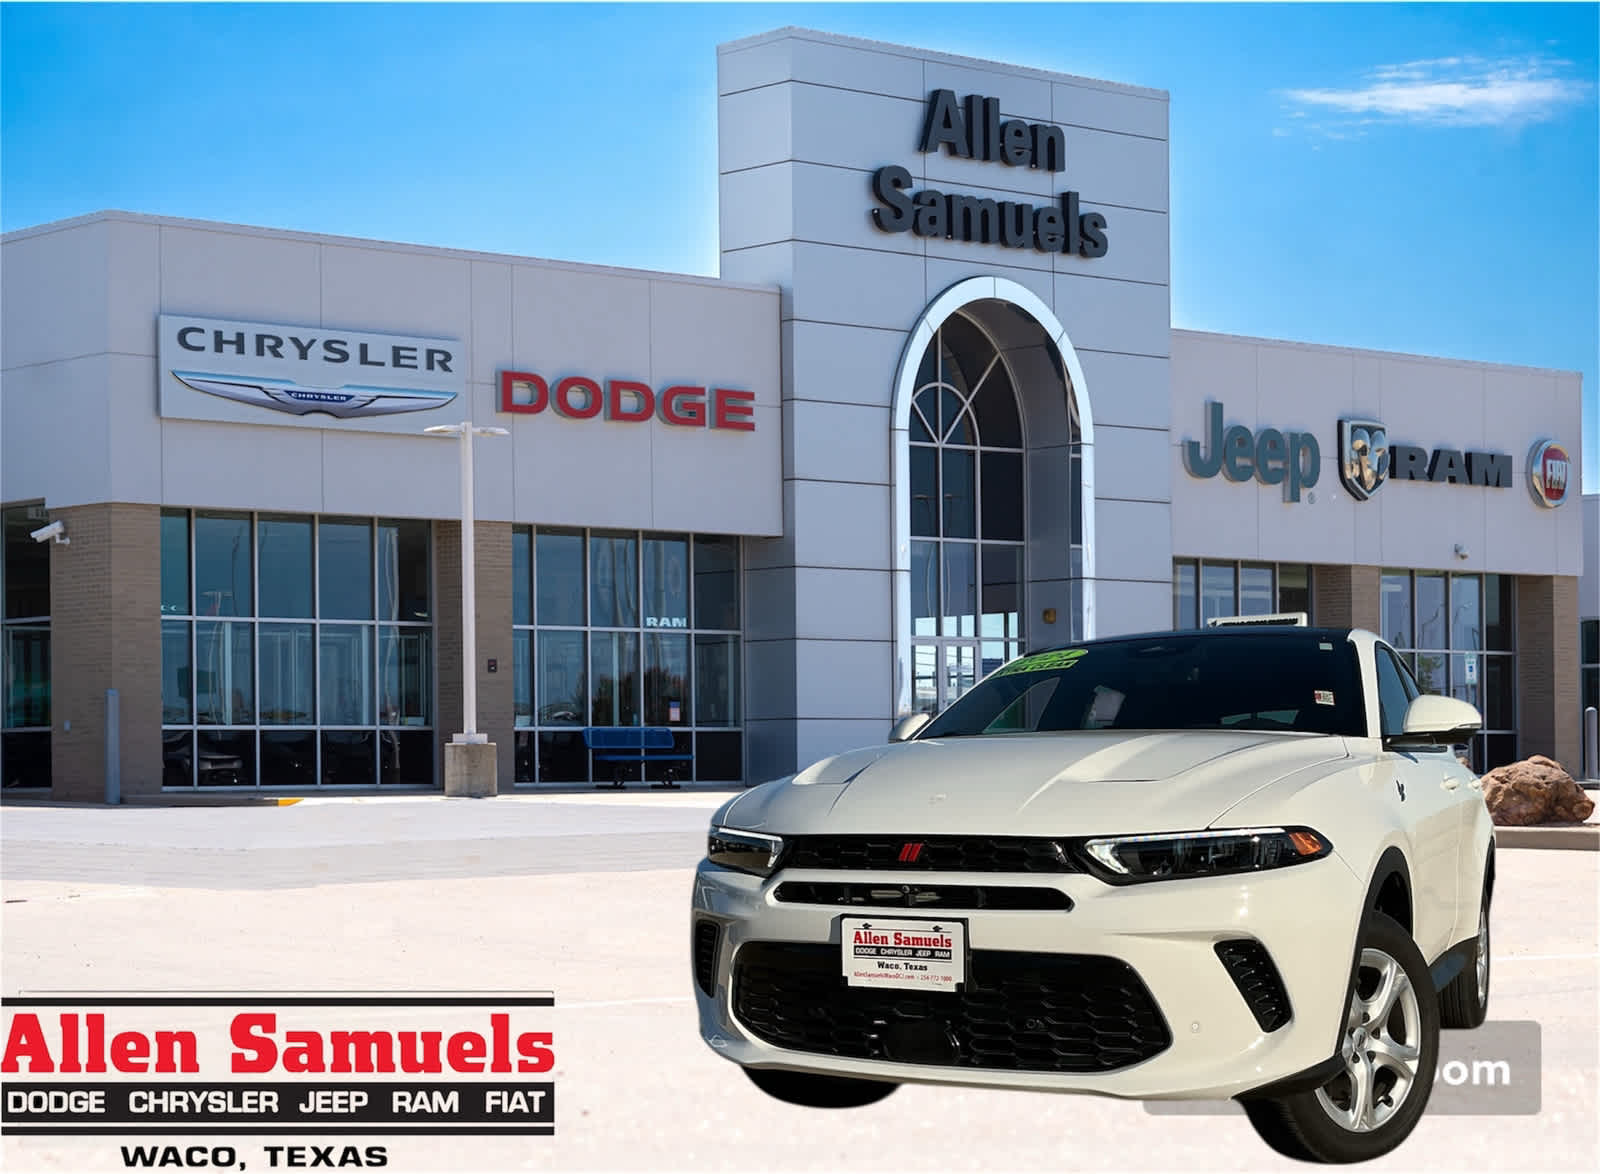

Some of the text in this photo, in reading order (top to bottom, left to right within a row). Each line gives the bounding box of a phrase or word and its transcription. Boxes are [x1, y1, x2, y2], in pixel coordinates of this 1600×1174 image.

[918, 88, 1066, 173] Allen
[871, 165, 1109, 258] Samuels
[176, 326, 454, 373] CHRYSLER
[290, 392, 347, 401] CHRYSLER
[496, 370, 756, 433] DODGE
[1182, 400, 1321, 503] Jeep
[1389, 444, 1513, 489] RAM
[1545, 458, 1567, 490] FIAT
[646, 616, 687, 628] RAM
[853, 931, 952, 947] Allen Samuels
[855, 947, 950, 958] DODGE CHRYSLER JEEP RAM
[903, 962, 928, 971] Texas
